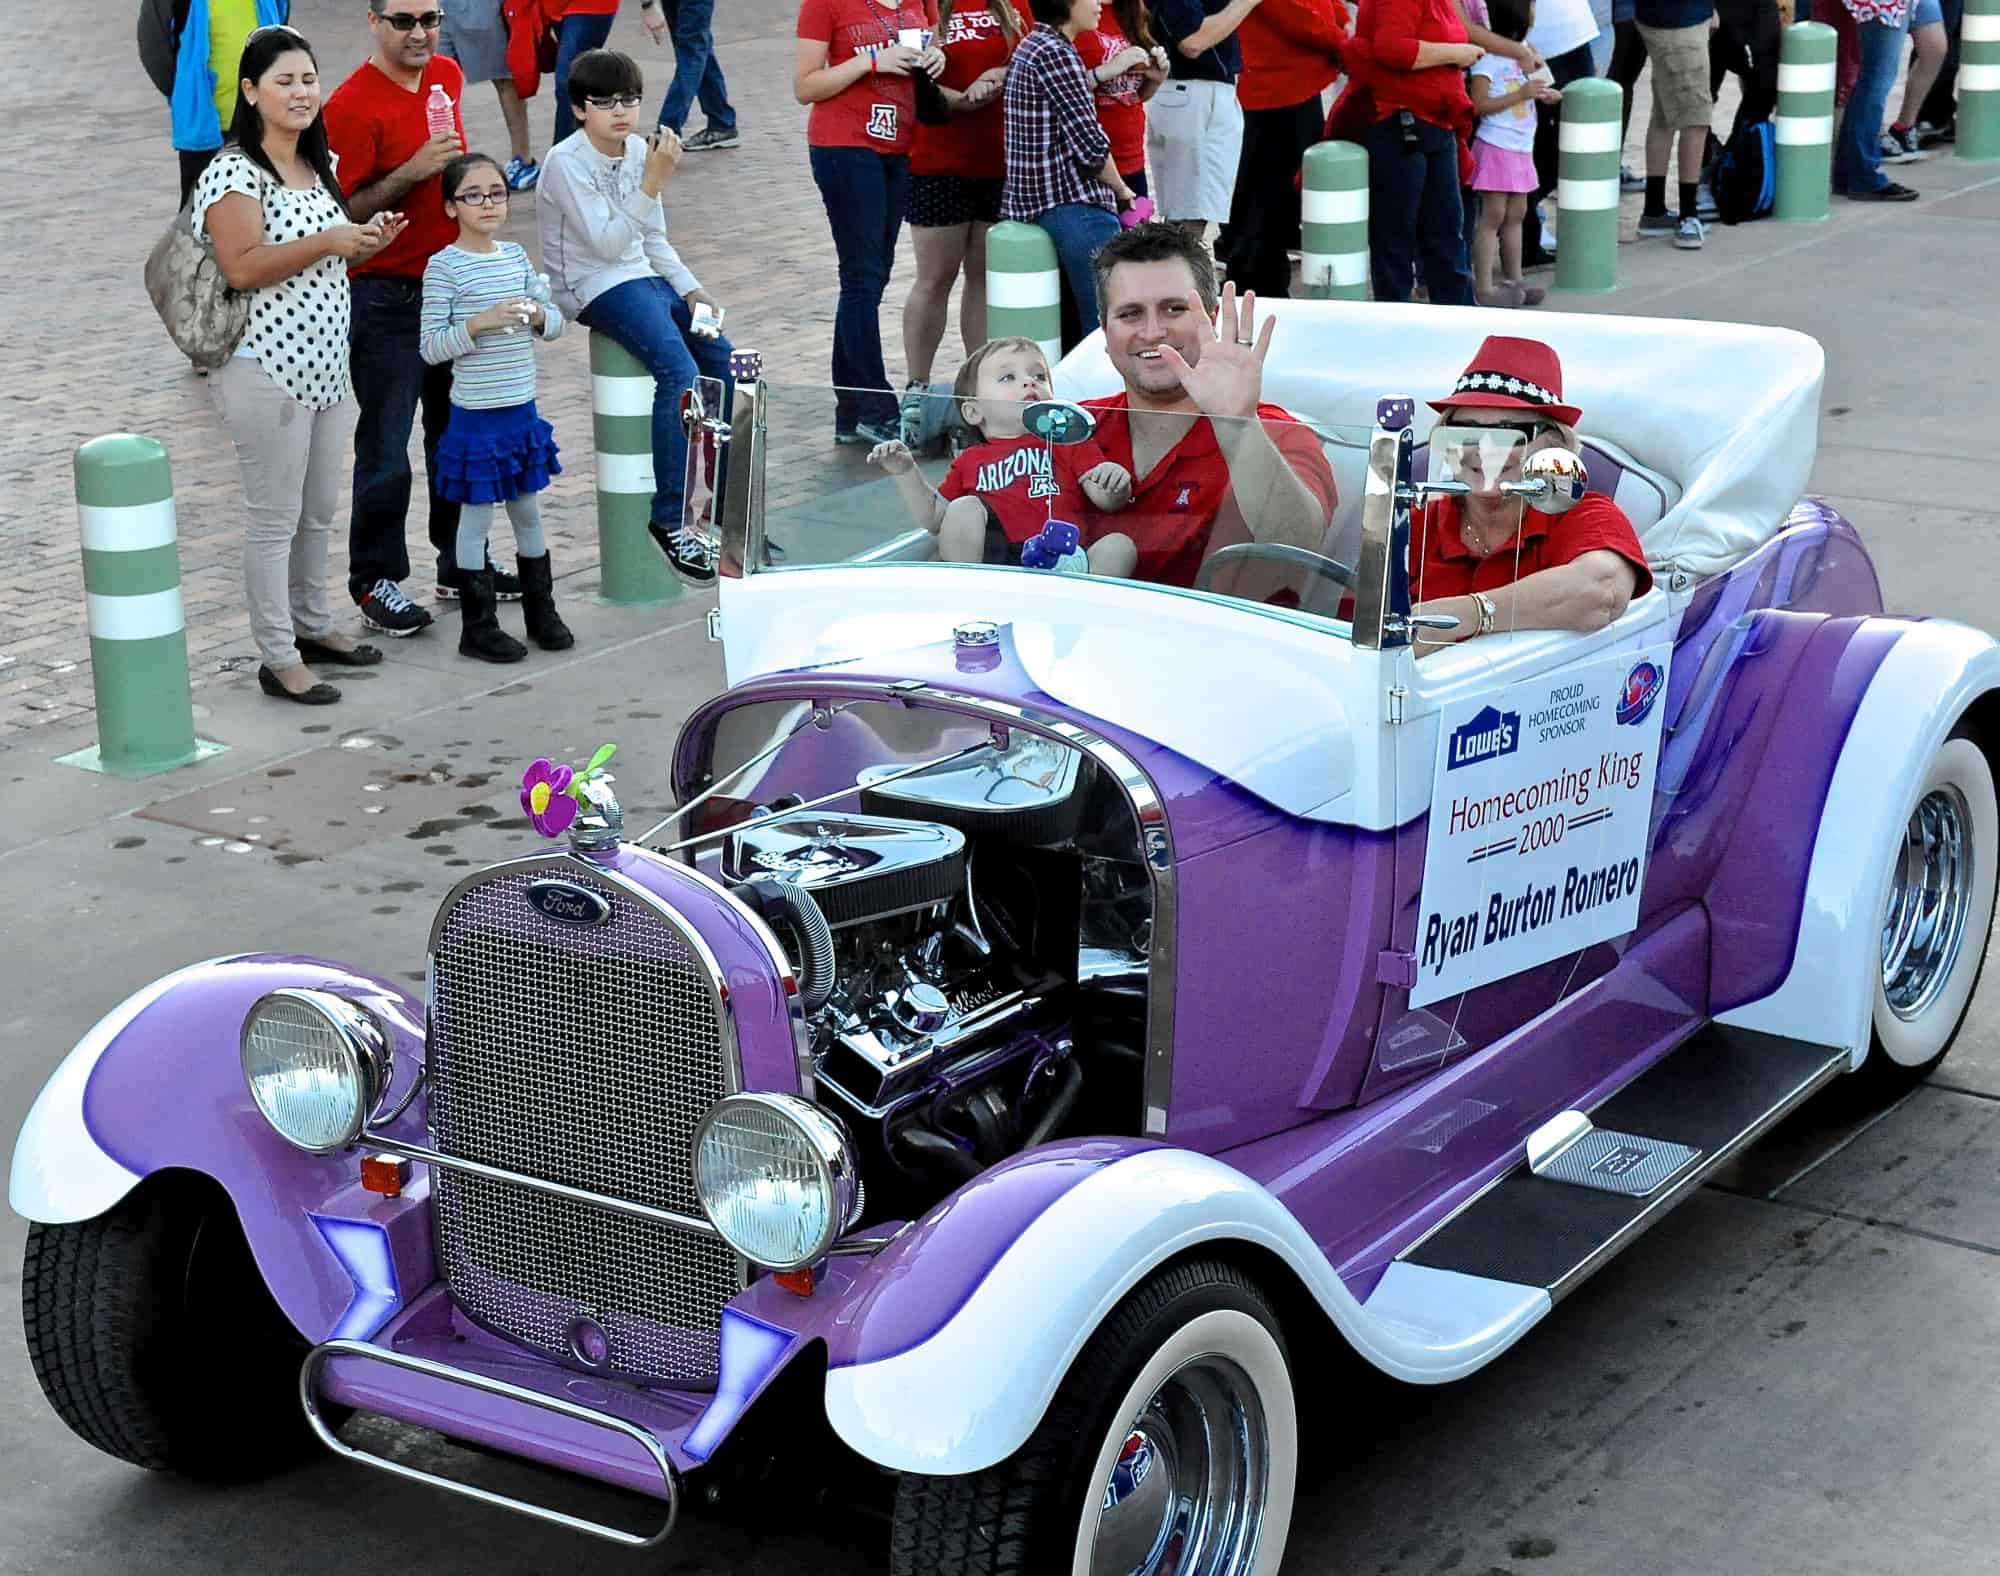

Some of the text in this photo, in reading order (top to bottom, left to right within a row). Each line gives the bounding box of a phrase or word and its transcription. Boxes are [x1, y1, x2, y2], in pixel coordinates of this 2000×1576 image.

[865, 104, 897, 141] A
[975, 447, 1053, 493] ARIZONA
[1528, 695, 1601, 728] HOMECOMING
[1549, 683, 1584, 706] PROUD
[1455, 723, 1513, 762] LOWE'S
[1538, 718, 1586, 743] SPONSOR
[1448, 751, 1644, 835] Homecoming King
[1517, 813, 1565, 856] 2000
[543, 889, 586, 918] Ford
[1421, 856, 1639, 977] Ryan Burton Romero
